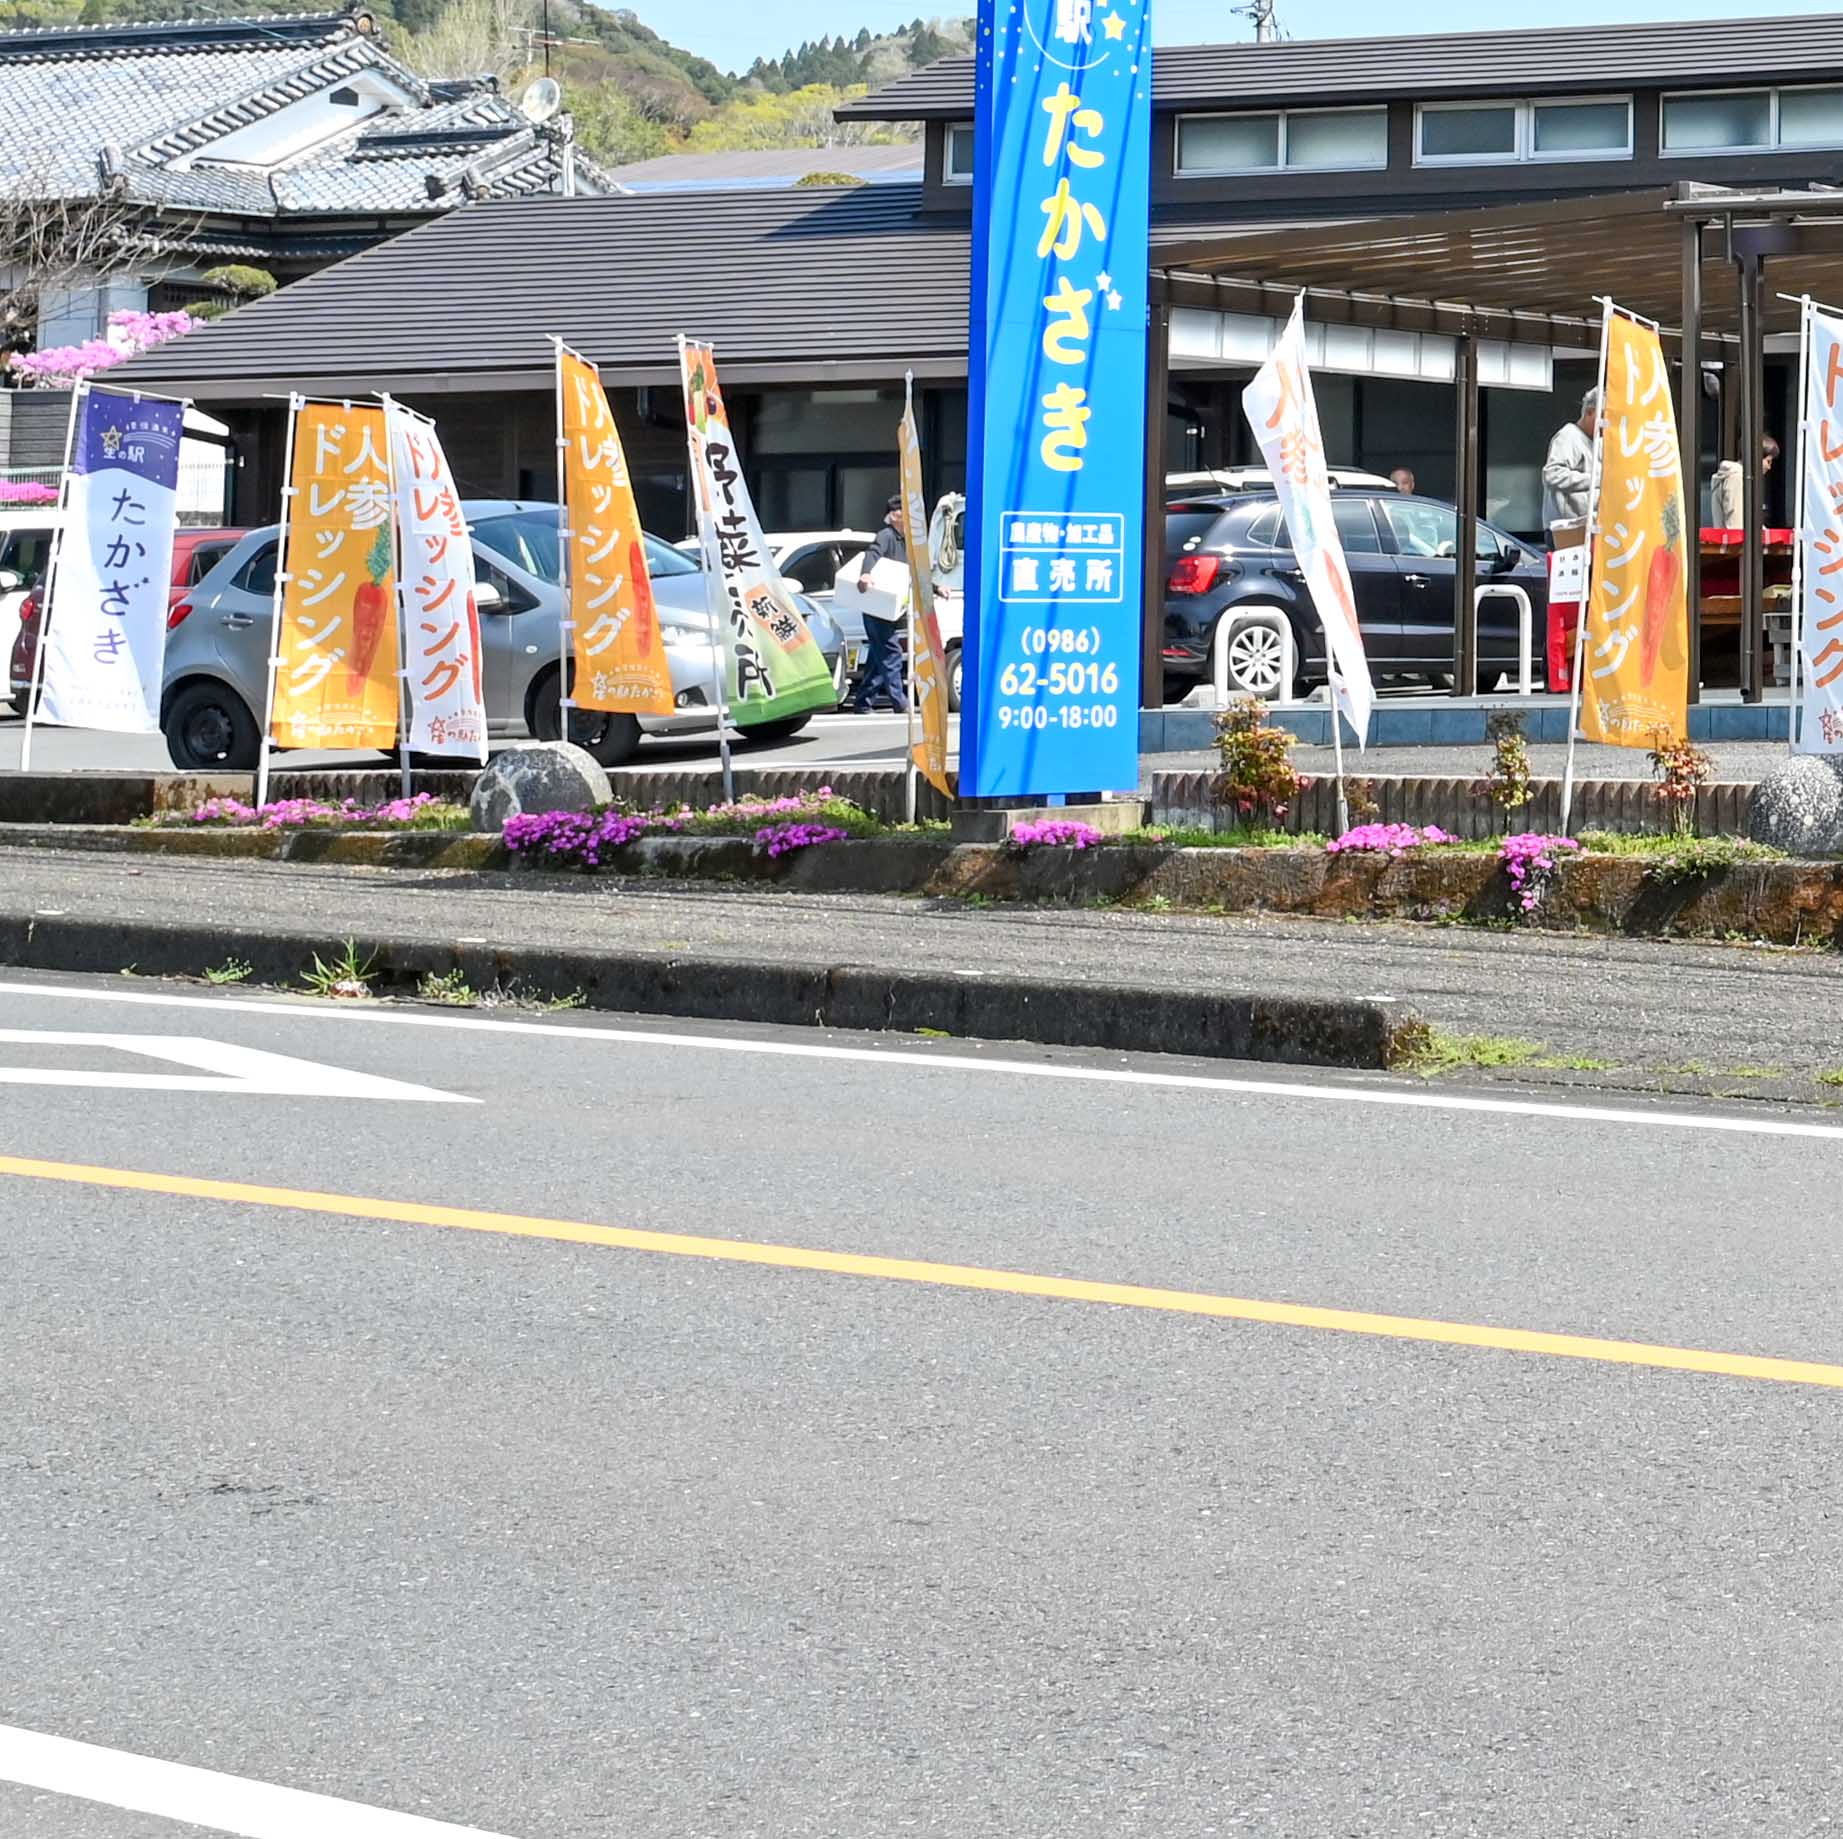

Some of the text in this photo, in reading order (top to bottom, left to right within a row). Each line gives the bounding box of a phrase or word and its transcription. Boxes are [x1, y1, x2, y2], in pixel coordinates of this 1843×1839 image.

[1036, 81, 1123, 472] たかざき
[343, 425, 391, 530] 人参
[1641, 345, 1680, 479] 人参
[92, 487, 149, 664] たかざき
[288, 423, 347, 697] ドレッシング
[405, 430, 468, 701] ドレッシング
[575, 374, 631, 657] ドレッシング
[1012, 557, 1114, 593] 直売所
[1592, 341, 1645, 679] ドレッシング
[998, 705, 1119, 730] 9:00-18:00
[1000, 662, 1119, 696] 62-5016
[1020, 626, 1102, 656] (0986)
